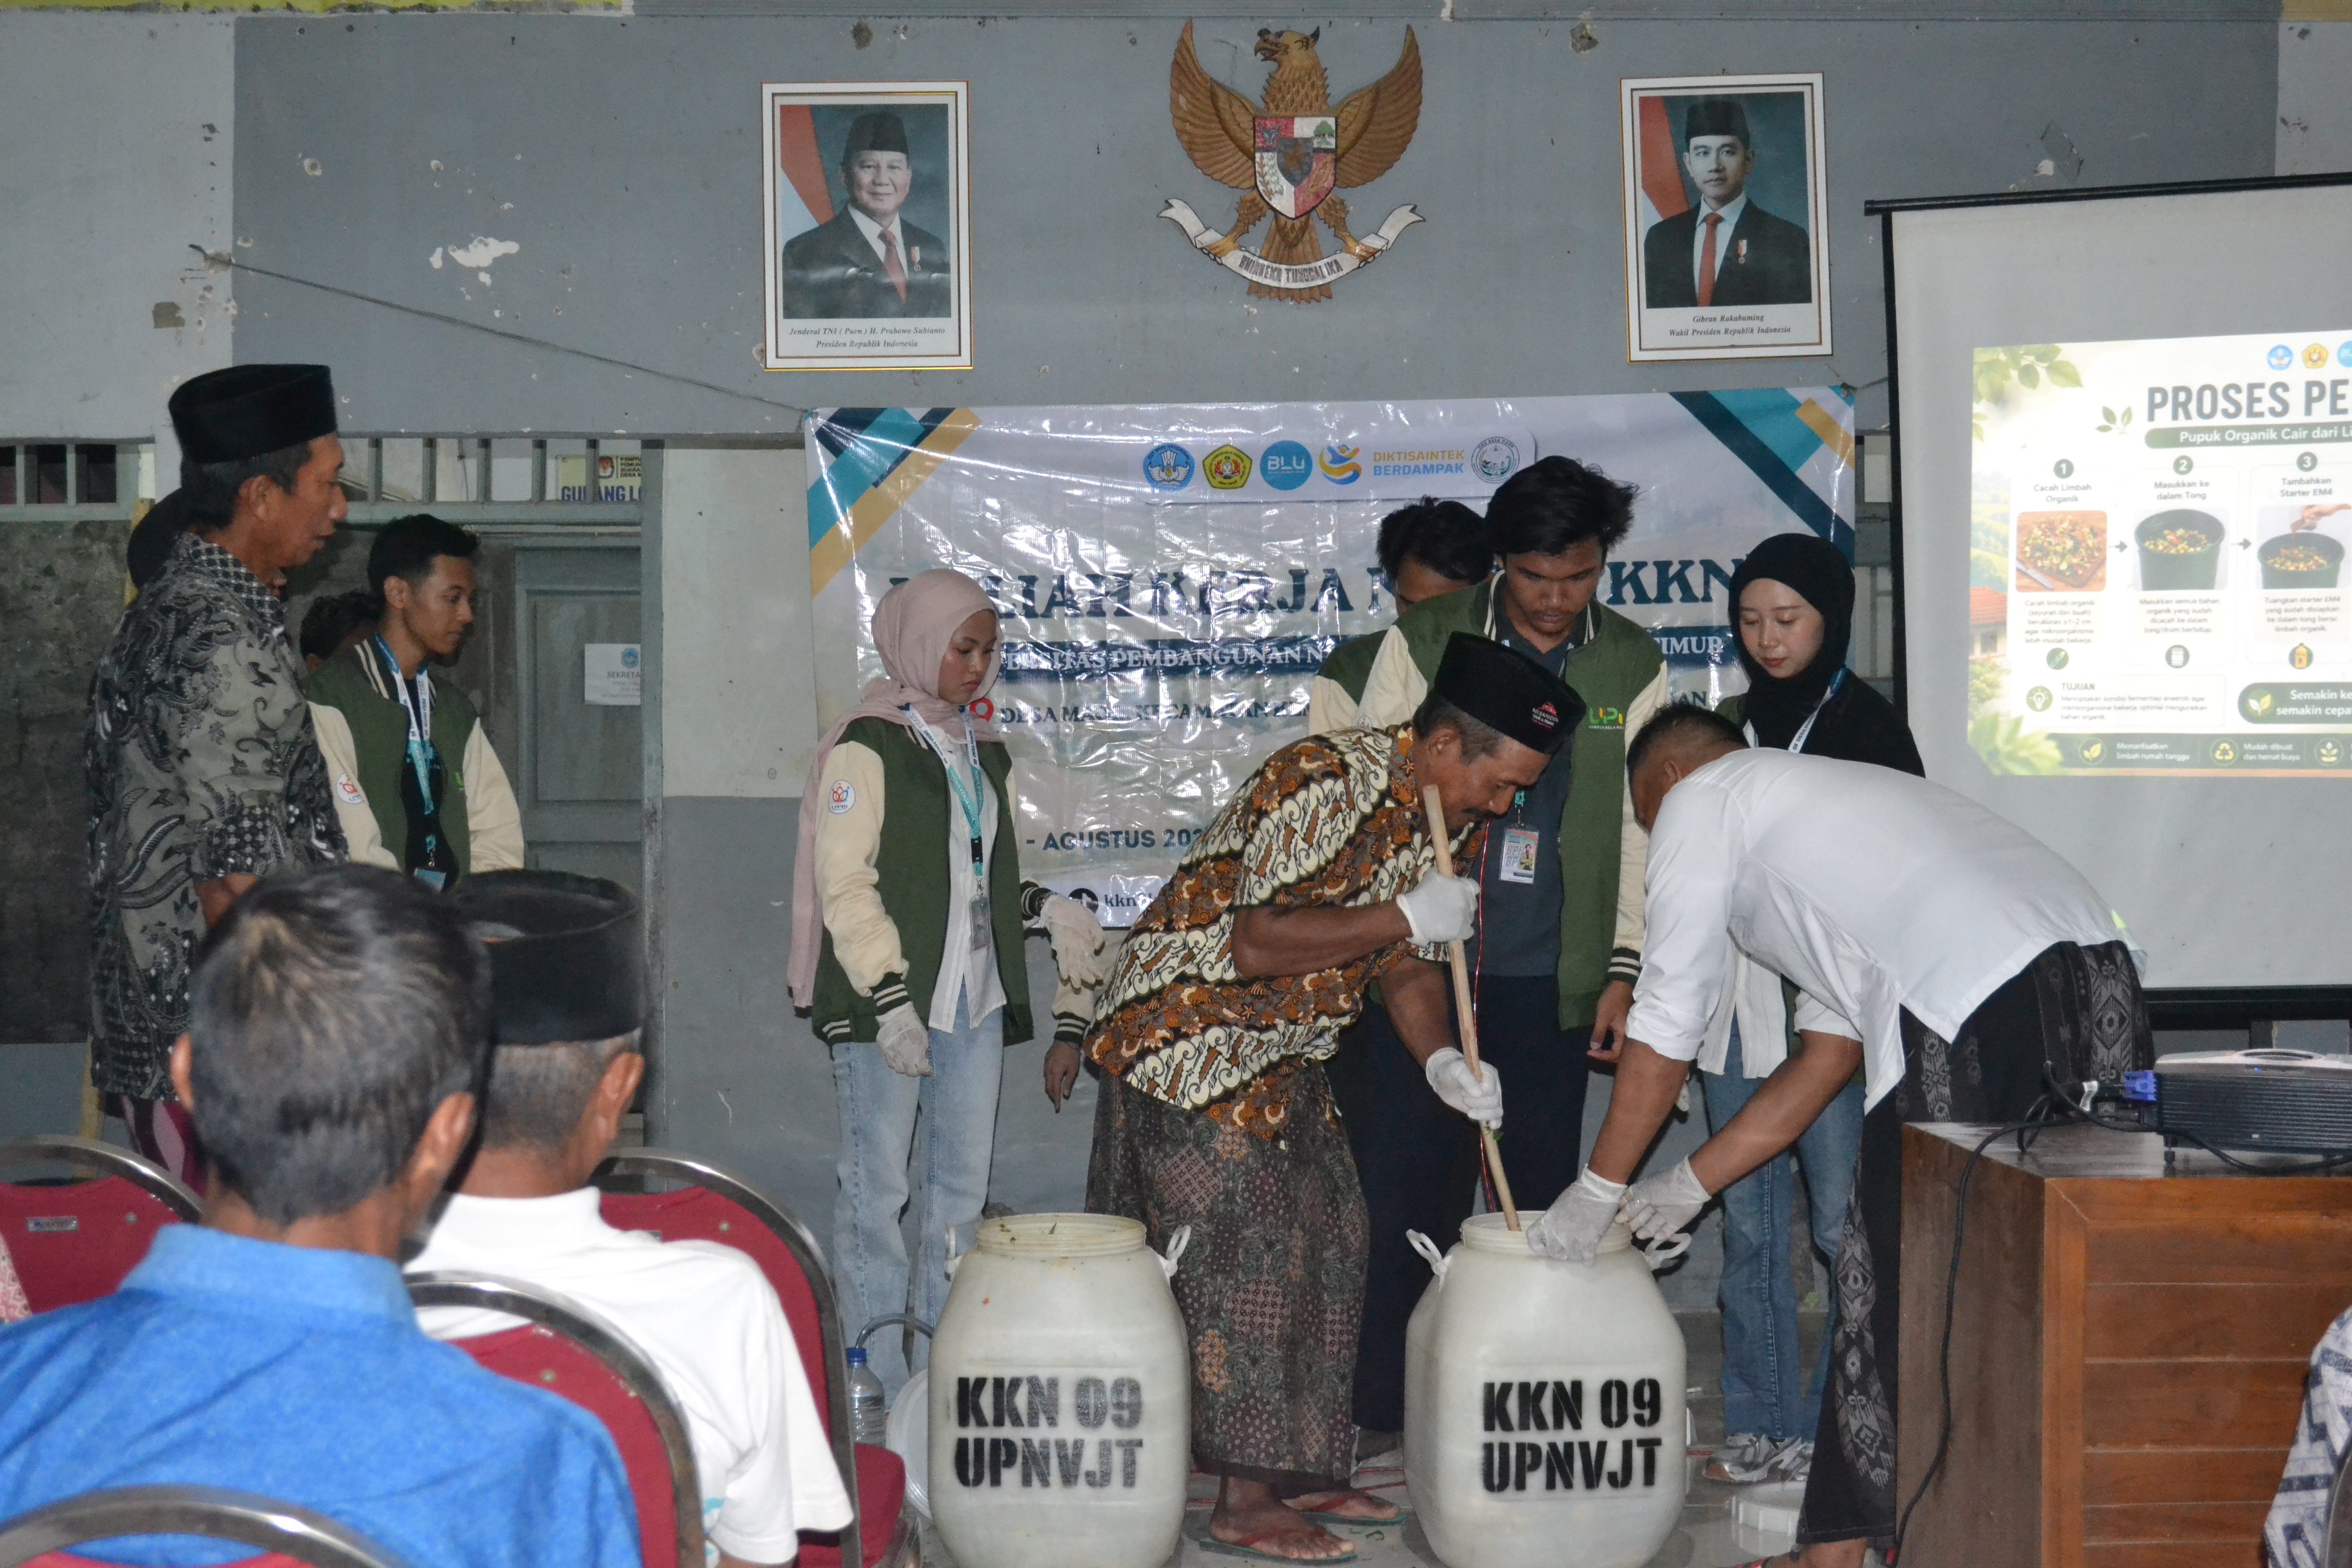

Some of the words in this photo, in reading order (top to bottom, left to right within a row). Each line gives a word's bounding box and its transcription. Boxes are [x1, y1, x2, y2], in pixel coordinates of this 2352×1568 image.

[1693, 314, 1717, 323] Gibran
[1720, 314, 1765, 323] Rakabuming
[1692, 328, 1721, 336] Presiden
[1724, 327, 1754, 336] Republik
[849, 340, 881, 349] Republik
[883, 339, 918, 348] Indonesia
[2147, 381, 2290, 423] PROSES
[2304, 379, 2352, 416] PE
[2180, 430, 2220, 444] Pupuk
[2225, 427, 2277, 444] Organik
[2281, 427, 2307, 439] Cair
[2312, 426, 2338, 438] dari
[1373, 449, 1465, 462] DIKTISAINTEK
[1268, 455, 1305, 470] BLU
[2179, 459, 2187, 471] 2
[2302, 456, 2312, 468] 3
[1373, 462, 1464, 476] BERDAMPAK
[2060, 463, 2066, 474] 1
[2154, 480, 2197, 489] Masukkan
[2282, 477, 2332, 485] Tambahkan
[2061, 483, 2092, 492] Limbah
[2280, 488, 2310, 497] Starter
[2313, 488, 2333, 496] EM4
[2046, 495, 2079, 504] Organik
[2157, 492, 2182, 500] dalam
[2185, 492, 2207, 501] Tong
[1654, 636, 1724, 654] IMUR
[1111, 645, 1304, 669] PEMBANGUNAN
[2290, 689, 2337, 700] Semakin
[2276, 705, 2321, 715] semakin
[2165, 753, 2190, 762] tangga
[2281, 753, 2300, 762] biaya
[1043, 829, 1156, 850] AGUSTUS
[958, 1376, 1058, 1427] KKN
[1075, 1376, 1142, 1429] 09
[1483, 1380, 1582, 1431] KKN
[1600, 1378, 1661, 1428] 09
[954, 1437, 1143, 1487] UPNVJT
[1482, 1437, 1662, 1492] UPNVJT
